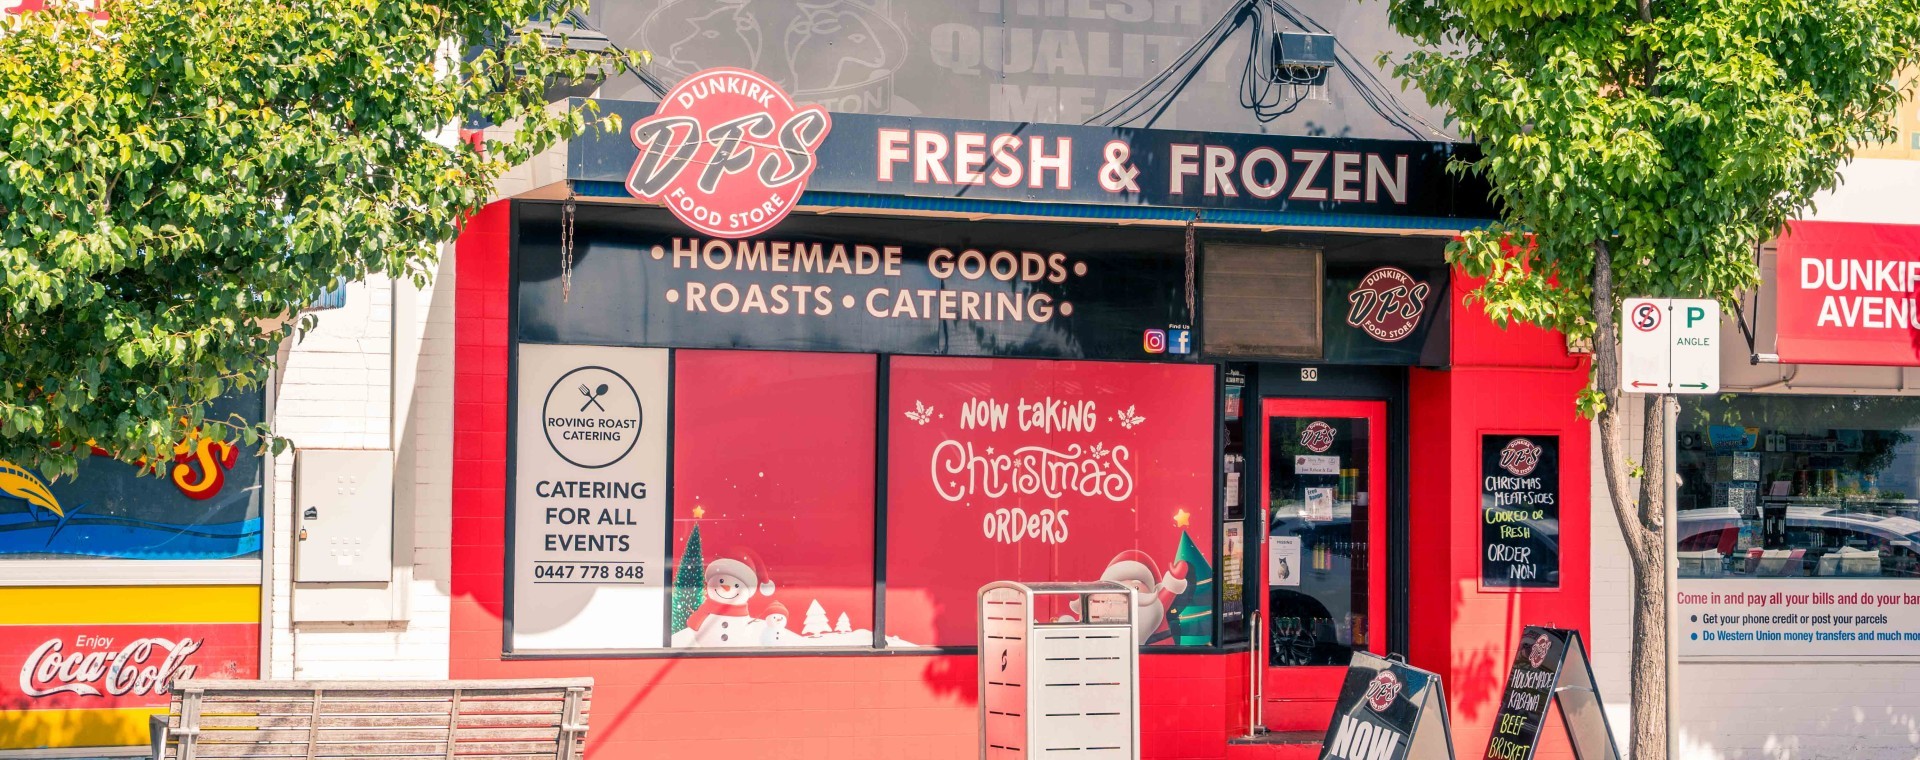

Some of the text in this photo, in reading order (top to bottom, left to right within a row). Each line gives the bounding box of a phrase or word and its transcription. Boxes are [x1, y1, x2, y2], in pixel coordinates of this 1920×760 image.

[930, 23, 1241, 83] QUALITY
[678, 77, 775, 109] DUNKIRK
[630, 108, 827, 197] DFS
[878, 129, 1409, 205] FRESH & FROZEN
[671, 187, 784, 228] FOOD STORE
[672, 238, 1068, 284] HOMEMADE GOODS
[1366, 270, 1408, 286] DUNKIRK
[686, 282, 1054, 323] ROASTS CATERING
[1349, 282, 1429, 326] DFS
[1687, 307, 1705, 328] P
[1365, 320, 1413, 338] FOOD STORE
[1676, 337, 1710, 346] ANGLE
[1302, 369, 1317, 379] 30
[548, 418, 637, 429] ROVING ROAST
[562, 431, 621, 441] CATERING
[1500, 447, 1541, 467] DFS
[536, 480, 647, 499] CATERING
[1485, 476, 1542, 491] CHRISTMAS
[545, 508, 637, 525] FOR ALL
[1501, 525, 1530, 539] FRESH
[545, 534, 630, 552] EVENTS
[1488, 544, 1530, 563] ORDER
[535, 565, 644, 579] 0447 778 848
[1510, 564, 1536, 579] NOW
[1677, 592, 1708, 605] Come
[1711, 592, 1721, 605] in
[1724, 592, 1744, 605] and
[1747, 595, 1767, 607] pay
[1770, 592, 1782, 605] all
[1785, 595, 1809, 607] your
[1812, 592, 1834, 605] bills
[1838, 592, 1857, 605] and
[1861, 592, 1874, 605] do
[1877, 595, 1901, 607] your
[1703, 614, 1887, 626] Get your phone credit or post your parcels
[76, 635, 114, 649] Enjoy
[1703, 631, 1714, 641] Do
[1717, 631, 1753, 641] Western
[1756, 631, 1781, 641] Union
[1784, 633, 1813, 642] money
[1816, 631, 1855, 641] transfers
[1858, 631, 1874, 641] and
[1877, 631, 1902, 641] much
[19, 637, 204, 698] Coca-Cola
[1511, 669, 1555, 689] HOUSEMADE
[1507, 690, 1540, 711] KABANA
[1500, 713, 1527, 735] BEEF
[1331, 715, 1400, 760] NOW
[1488, 737, 1530, 760] BRISKET
